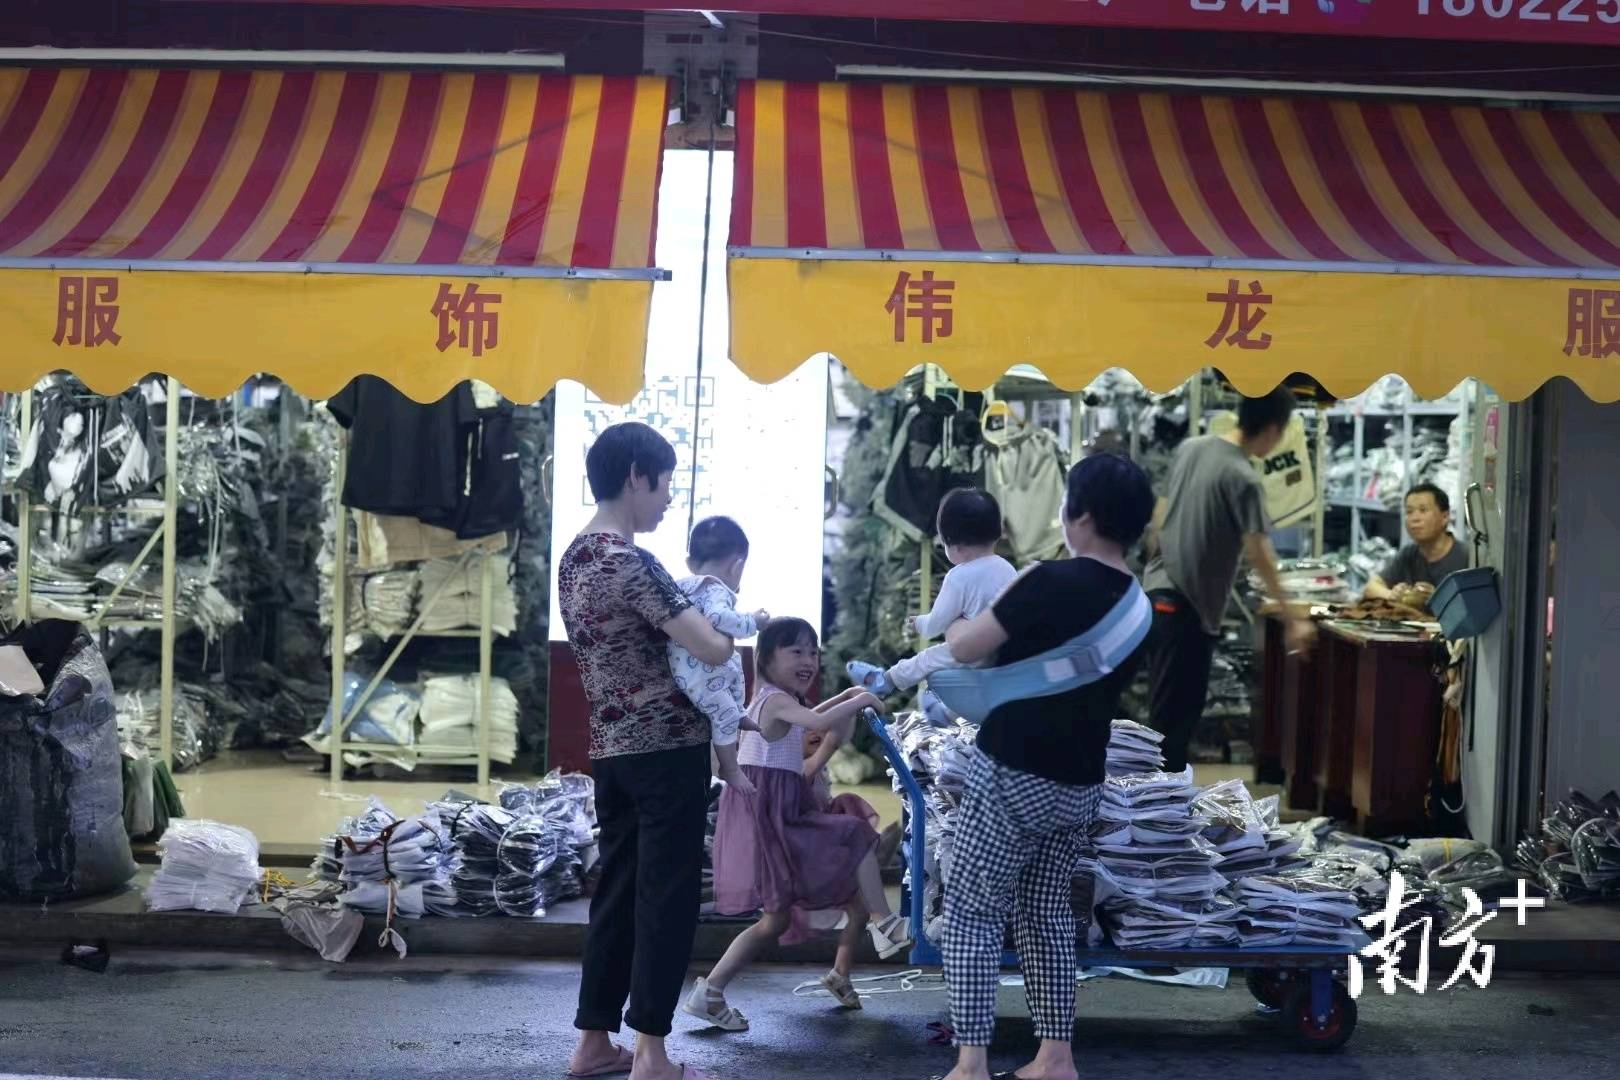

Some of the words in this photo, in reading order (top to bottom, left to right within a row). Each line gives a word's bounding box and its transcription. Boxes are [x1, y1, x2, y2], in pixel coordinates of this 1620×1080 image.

[52, 277, 121, 347] 服
[431, 283, 501, 356] 饰
[885, 271, 955, 343] 伟
[1204, 279, 1273, 350] 龙
[1562, 288, 1620, 358] 服
